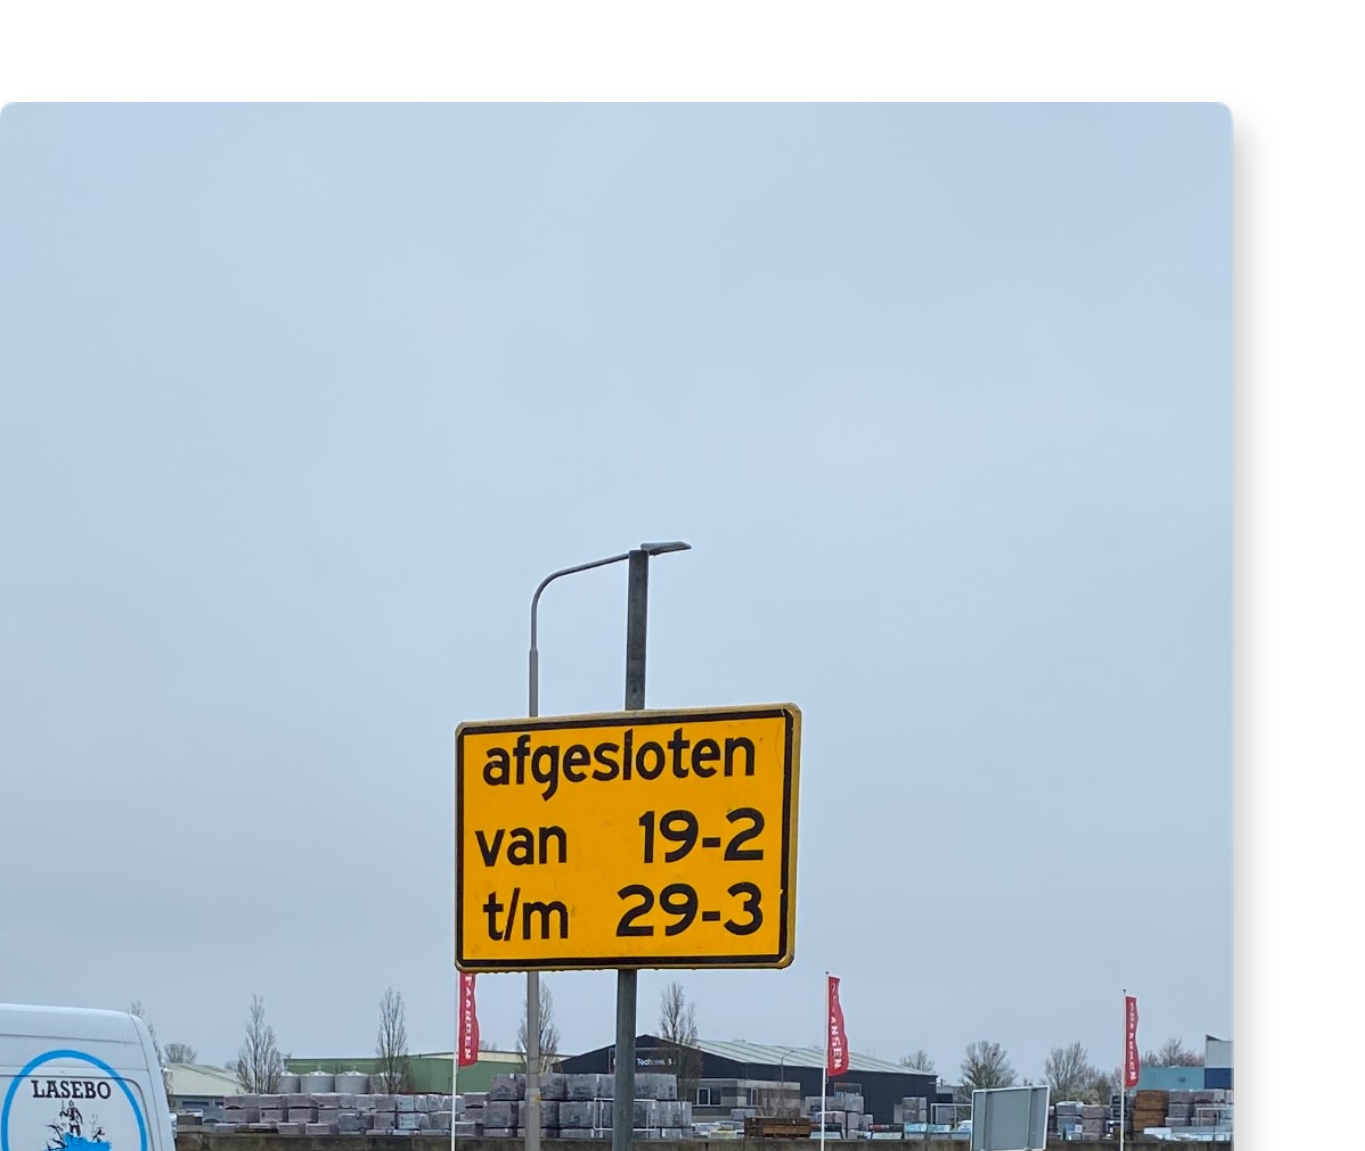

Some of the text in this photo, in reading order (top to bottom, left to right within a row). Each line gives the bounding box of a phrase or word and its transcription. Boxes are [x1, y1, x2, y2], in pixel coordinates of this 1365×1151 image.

[482, 727, 755, 801] afgesloten
[475, 807, 765, 867] van 19-2
[483, 881, 764, 941] t/m 29-3
[31, 1080, 112, 1099] LASEBO
